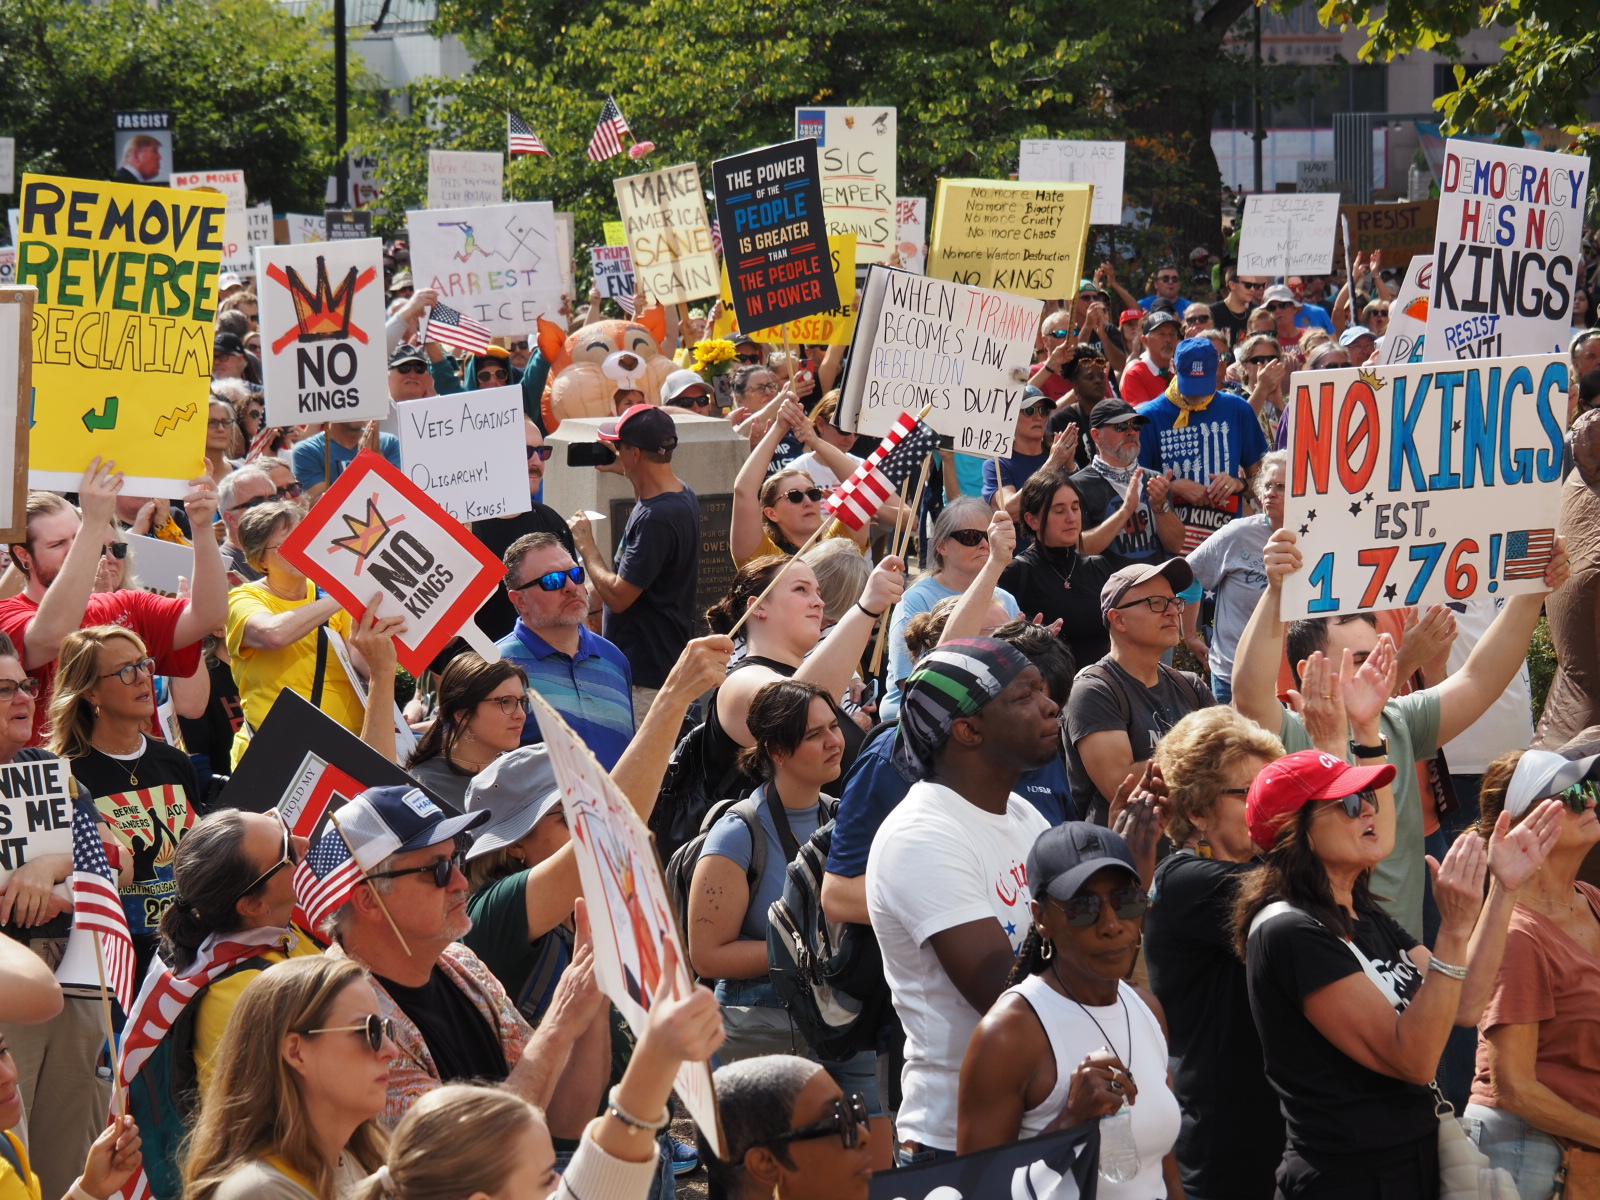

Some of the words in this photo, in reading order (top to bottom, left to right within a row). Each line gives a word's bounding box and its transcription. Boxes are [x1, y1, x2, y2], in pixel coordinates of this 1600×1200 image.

[117, 114, 169, 128] FASCIST
[824, 148, 877, 174] SIC
[1026, 142, 1050, 155] IF
[1056, 144, 1085, 158] YOU
[1091, 146, 1115, 160] ARE
[176, 174, 199, 187] NO
[206, 173, 238, 183] MORE
[725, 169, 752, 191] THE
[757, 156, 805, 184] POWER
[1304, 163, 1328, 173] HAVE
[1443, 153, 1584, 209] DEMOCRACY
[629, 168, 698, 208] MAKE
[756, 188, 765, 199] OF
[767, 185, 780, 197] THE
[1035, 190, 1064, 202] Hate
[23, 182, 226, 253] REMOVE
[734, 192, 807, 233] PEOPLE
[1026, 202, 1065, 216] Bigotry
[1251, 199, 1262, 214] I
[1270, 199, 1325, 213] BELIEVE
[1264, 214, 1286, 224] IN
[1292, 213, 1315, 222] THE
[1357, 207, 1421, 231] RESIST
[628, 207, 706, 235] AMERICA
[1021, 216, 1062, 228] Cruelty
[1023, 228, 1056, 240] Chaos
[1460, 200, 1515, 246] HAS
[1525, 208, 1564, 251] NO
[635, 227, 713, 268] SANE
[739, 237, 752, 254] IS
[755, 221, 809, 250] GREATER
[1277, 240, 1300, 251] NOT
[1358, 227, 1434, 251] RESTORE
[593, 246, 630, 260] TRUM
[768, 249, 788, 262] THAN
[1023, 249, 1070, 262] Destruction
[17, 241, 220, 322] REVERSE
[430, 269, 539, 298] ARREST
[641, 265, 712, 302] AGAIN
[738, 270, 766, 292] THE
[768, 256, 821, 285] PEOPLE
[953, 270, 981, 287] NO
[993, 268, 1054, 289] KINGS
[1434, 242, 1574, 321] KINGS
[473, 301, 539, 323] ICE
[746, 294, 763, 317] IN
[767, 279, 822, 311] POWER
[891, 274, 957, 322] WHEN
[966, 289, 1040, 343] TYRANNY
[32, 308, 212, 377] RECLAIM
[884, 311, 964, 354] BECOMES
[971, 335, 1007, 372] LAW.
[1444, 315, 1500, 350] RESIST
[296, 342, 358, 389] NO
[874, 346, 965, 386] REBELLION
[298, 387, 360, 413] KINGS
[868, 380, 951, 410] BECOMES
[964, 388, 1018, 423] DUTY.
[961, 426, 1011, 455] 10-18-25
[1291, 379, 1380, 498] NO
[1388, 361, 1571, 492] KINGS
[706, 503, 726, 512] 1877
[1190, 507, 1233, 528] KINGS
[1374, 500, 1436, 539] EST.
[718, 529, 726, 537] OF
[366, 529, 436, 604] NO
[1307, 533, 1503, 614] 1776!
[403, 562, 455, 621] KINGS
[283, 786, 305, 818] HOLD
[301, 768, 316, 787] MY
[25, 798, 71, 833] ME
[112, 805, 141, 818] BERNIE
[116, 818, 151, 830] SANDERS
[166, 803, 187, 818] AOC
[118, 885, 156, 895] FIGHTING
